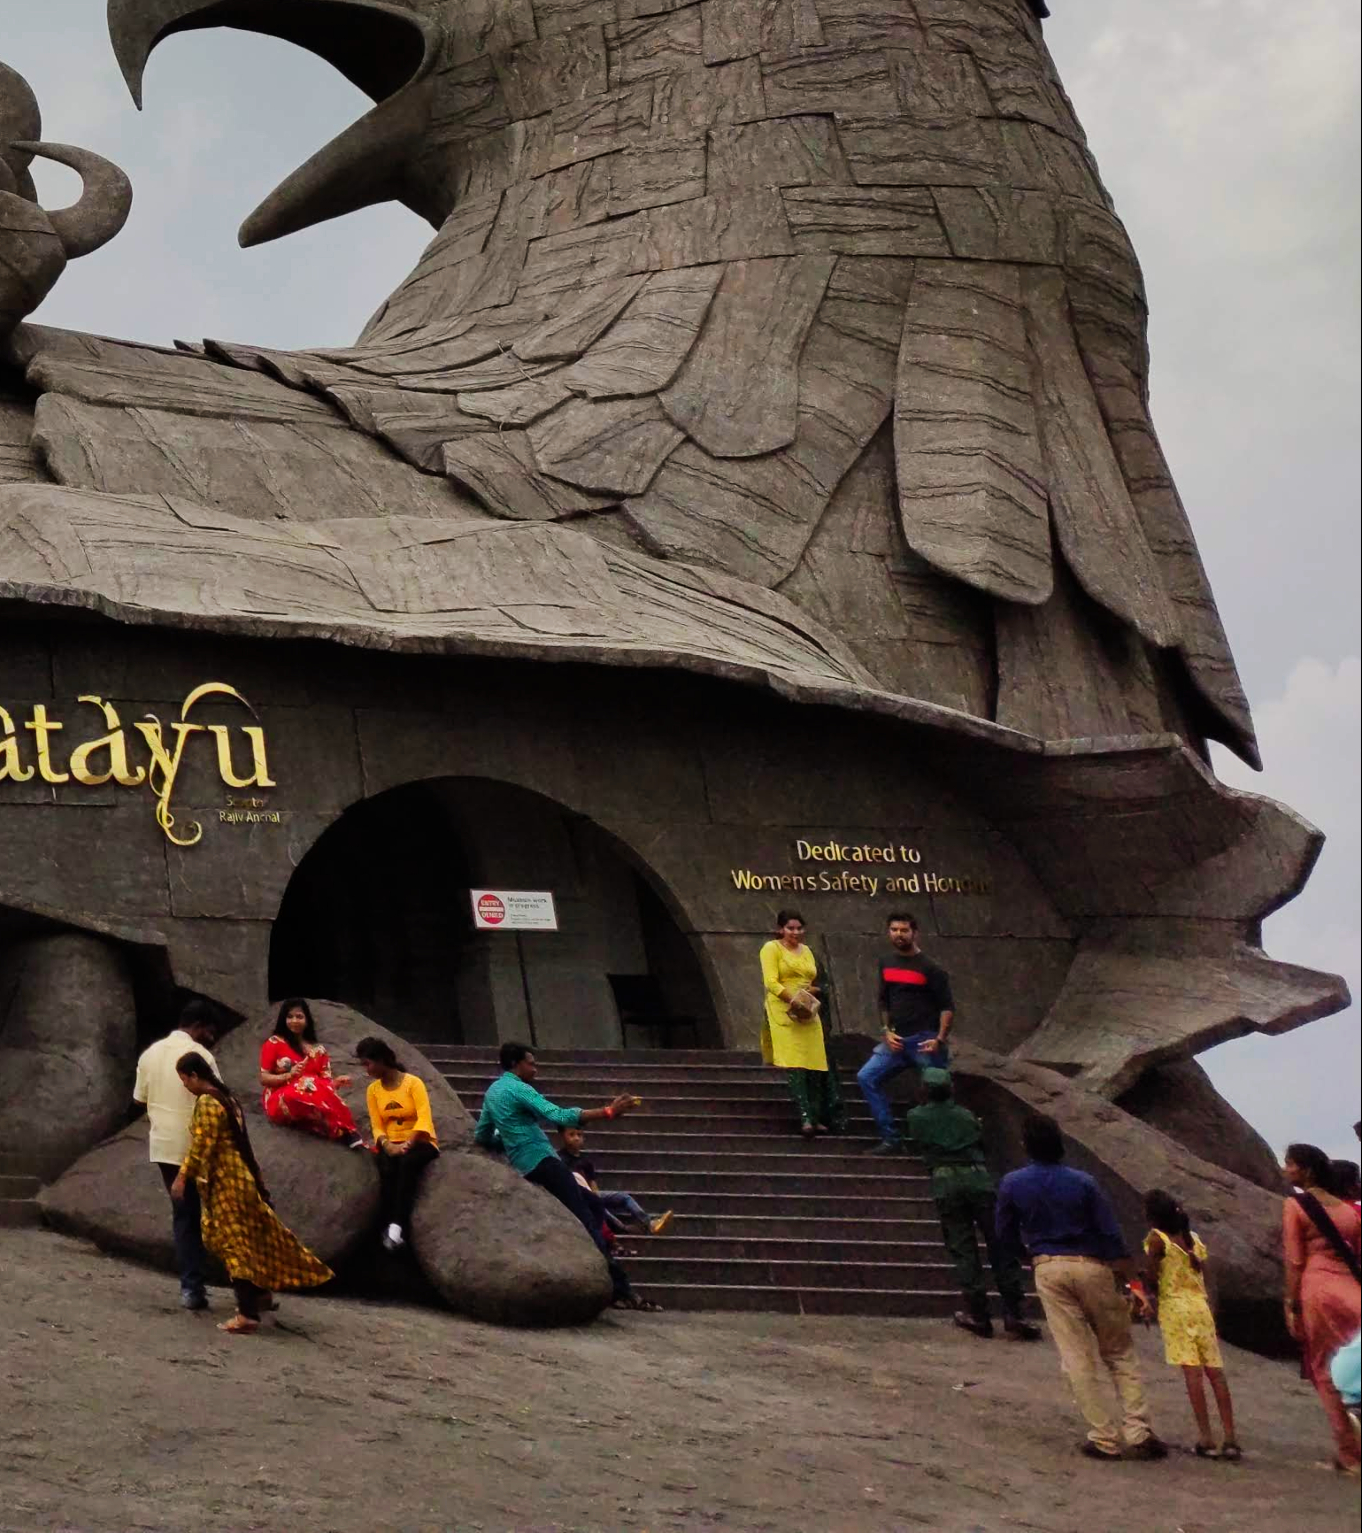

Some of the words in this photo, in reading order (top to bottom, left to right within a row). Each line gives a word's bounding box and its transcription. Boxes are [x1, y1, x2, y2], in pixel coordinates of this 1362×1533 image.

[219, 811, 244, 825] Rajiv
[796, 839, 896, 863] Dedicated
[900, 845, 922, 864] to
[819, 871, 878, 897] Safety
[885, 873, 920, 894] and
[923, 872, 992, 895] Hono
[480, 899, 501, 907] ENTRY
[481, 911, 504, 919] DENIED
